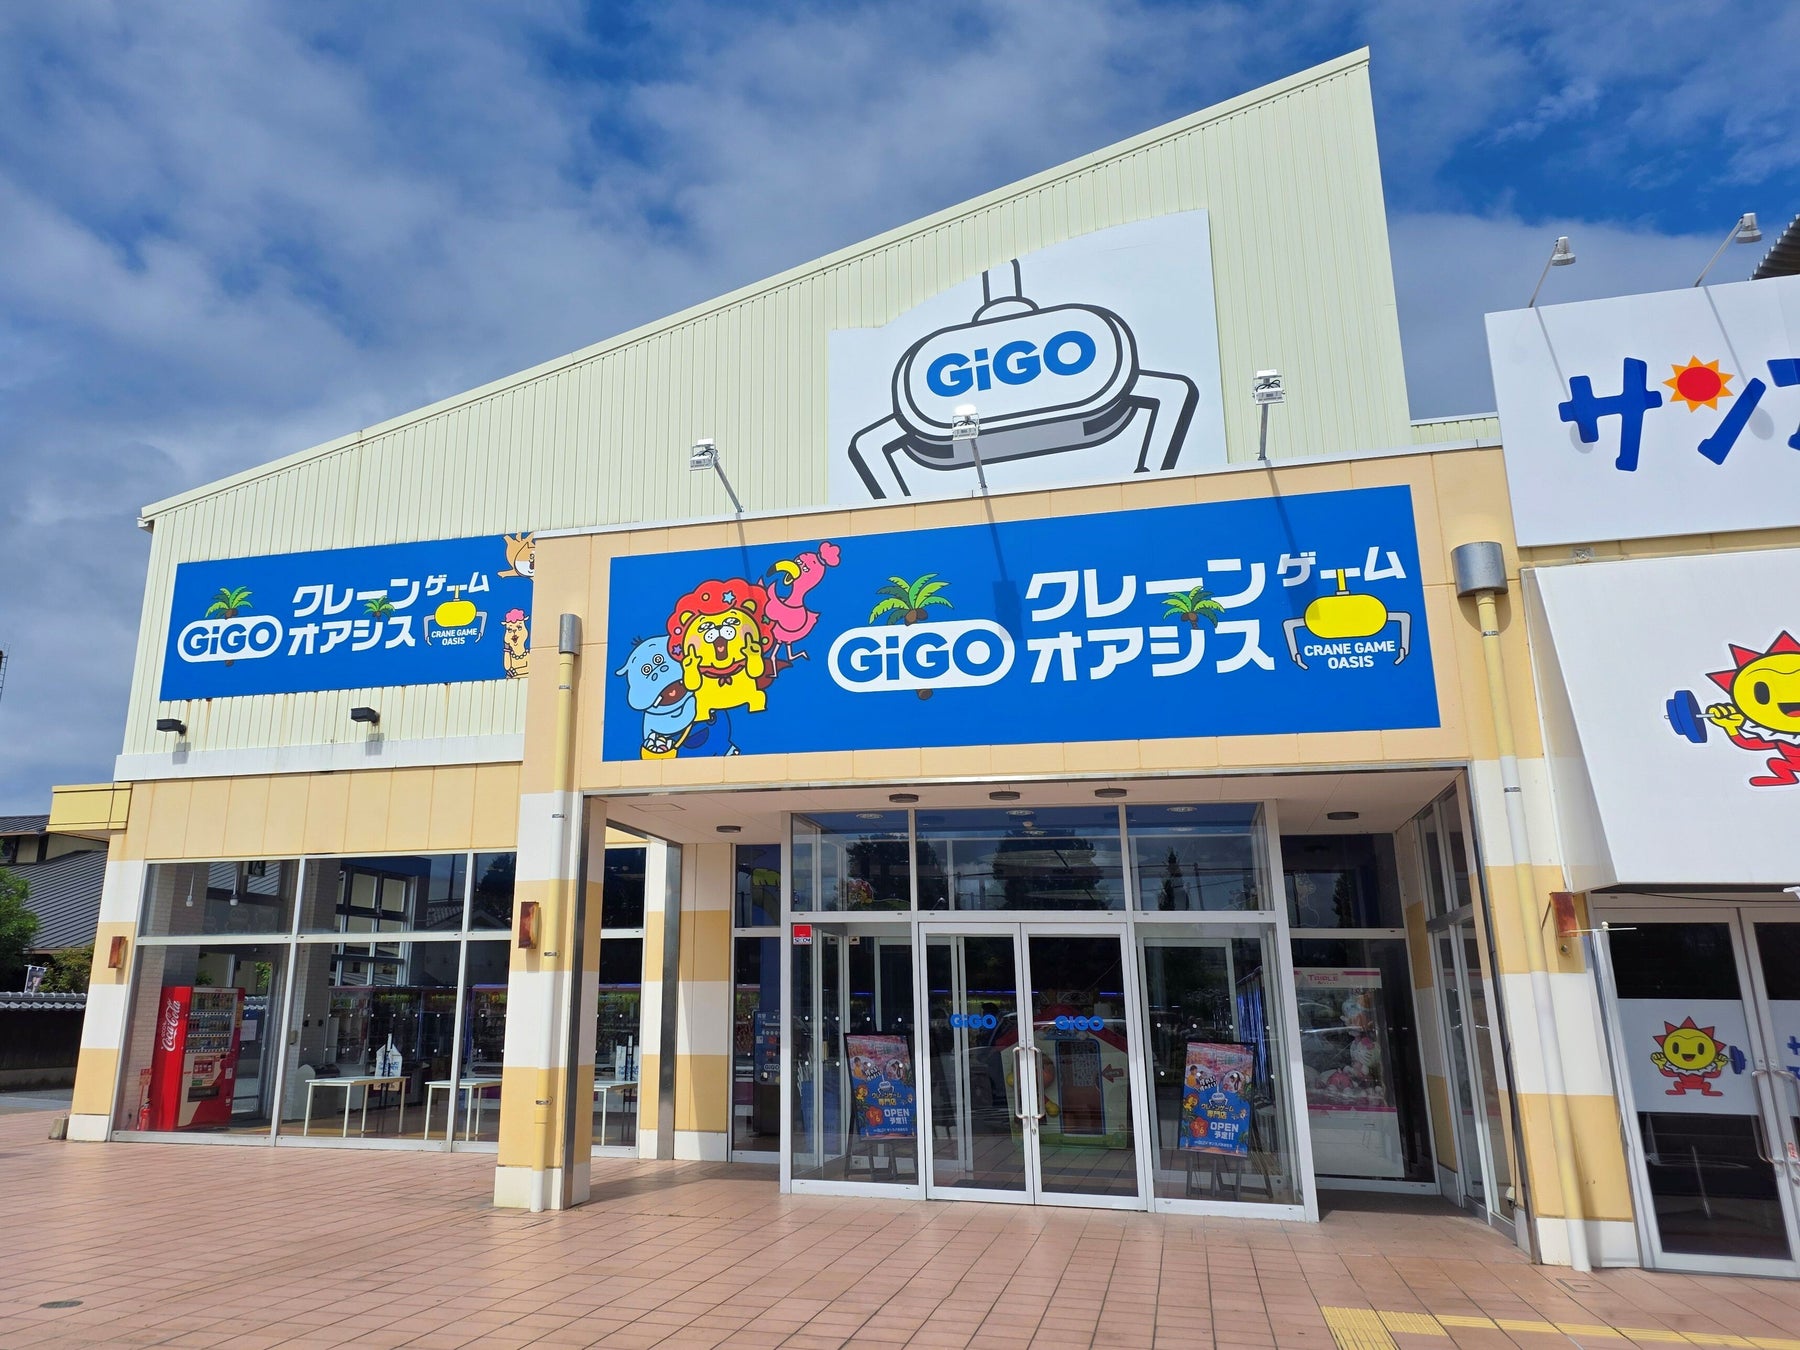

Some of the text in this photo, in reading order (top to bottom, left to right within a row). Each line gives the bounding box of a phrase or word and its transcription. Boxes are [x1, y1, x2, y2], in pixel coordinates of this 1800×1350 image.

[927, 331, 1097, 397] GiGO
[182, 621, 277, 657] GiGO
[287, 615, 416, 656] オアシス
[431, 628, 478, 639] CRANE GAME
[441, 636, 466, 646] OASIS
[838, 629, 1005, 683] GiGO
[1027, 619, 1275, 683] オアシス
[1304, 640, 1396, 657] CRANE GAME
[1327, 654, 1375, 670] OASIS
[950, 1013, 997, 1030] GiGO
[1054, 1015, 1105, 1031] GiGO
[884, 1108, 910, 1117] OPEN
[1210, 1122, 1239, 1132] OPEN
